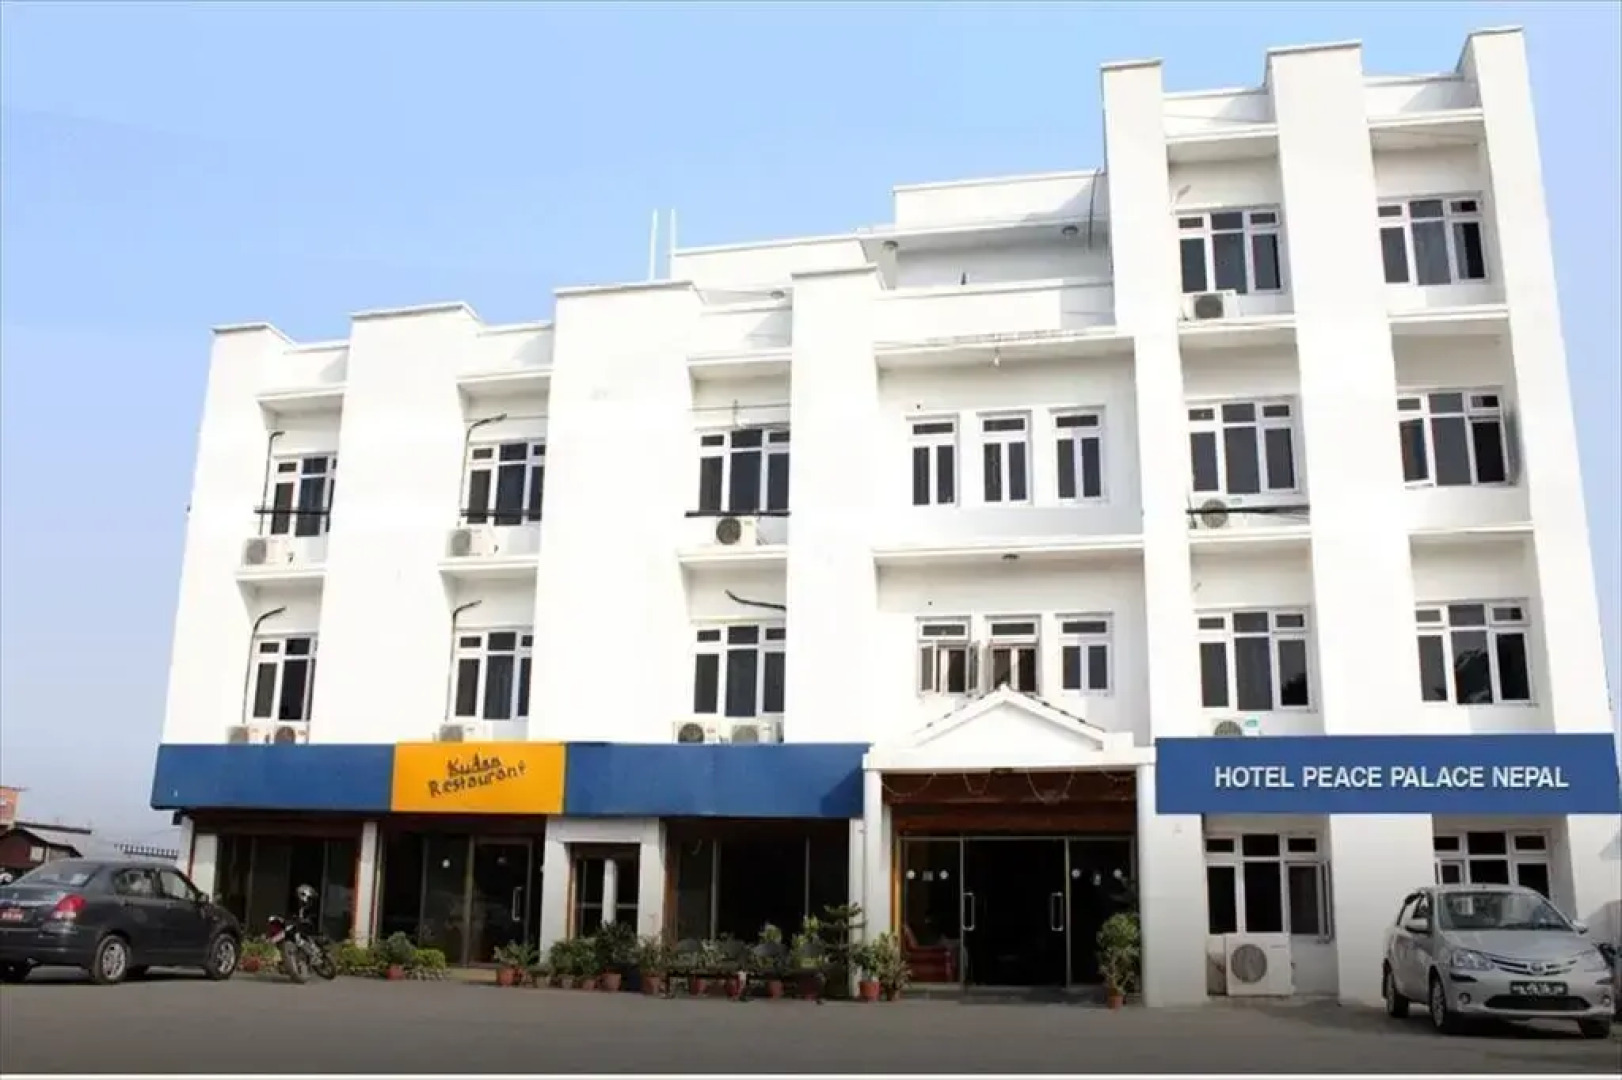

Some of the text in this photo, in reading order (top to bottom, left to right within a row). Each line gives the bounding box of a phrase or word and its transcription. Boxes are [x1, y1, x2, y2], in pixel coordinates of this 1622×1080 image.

[428, 760, 527, 798] Restaurant
[1215, 766, 1569, 788] HOTEL PEACE PALACE NEPAL
